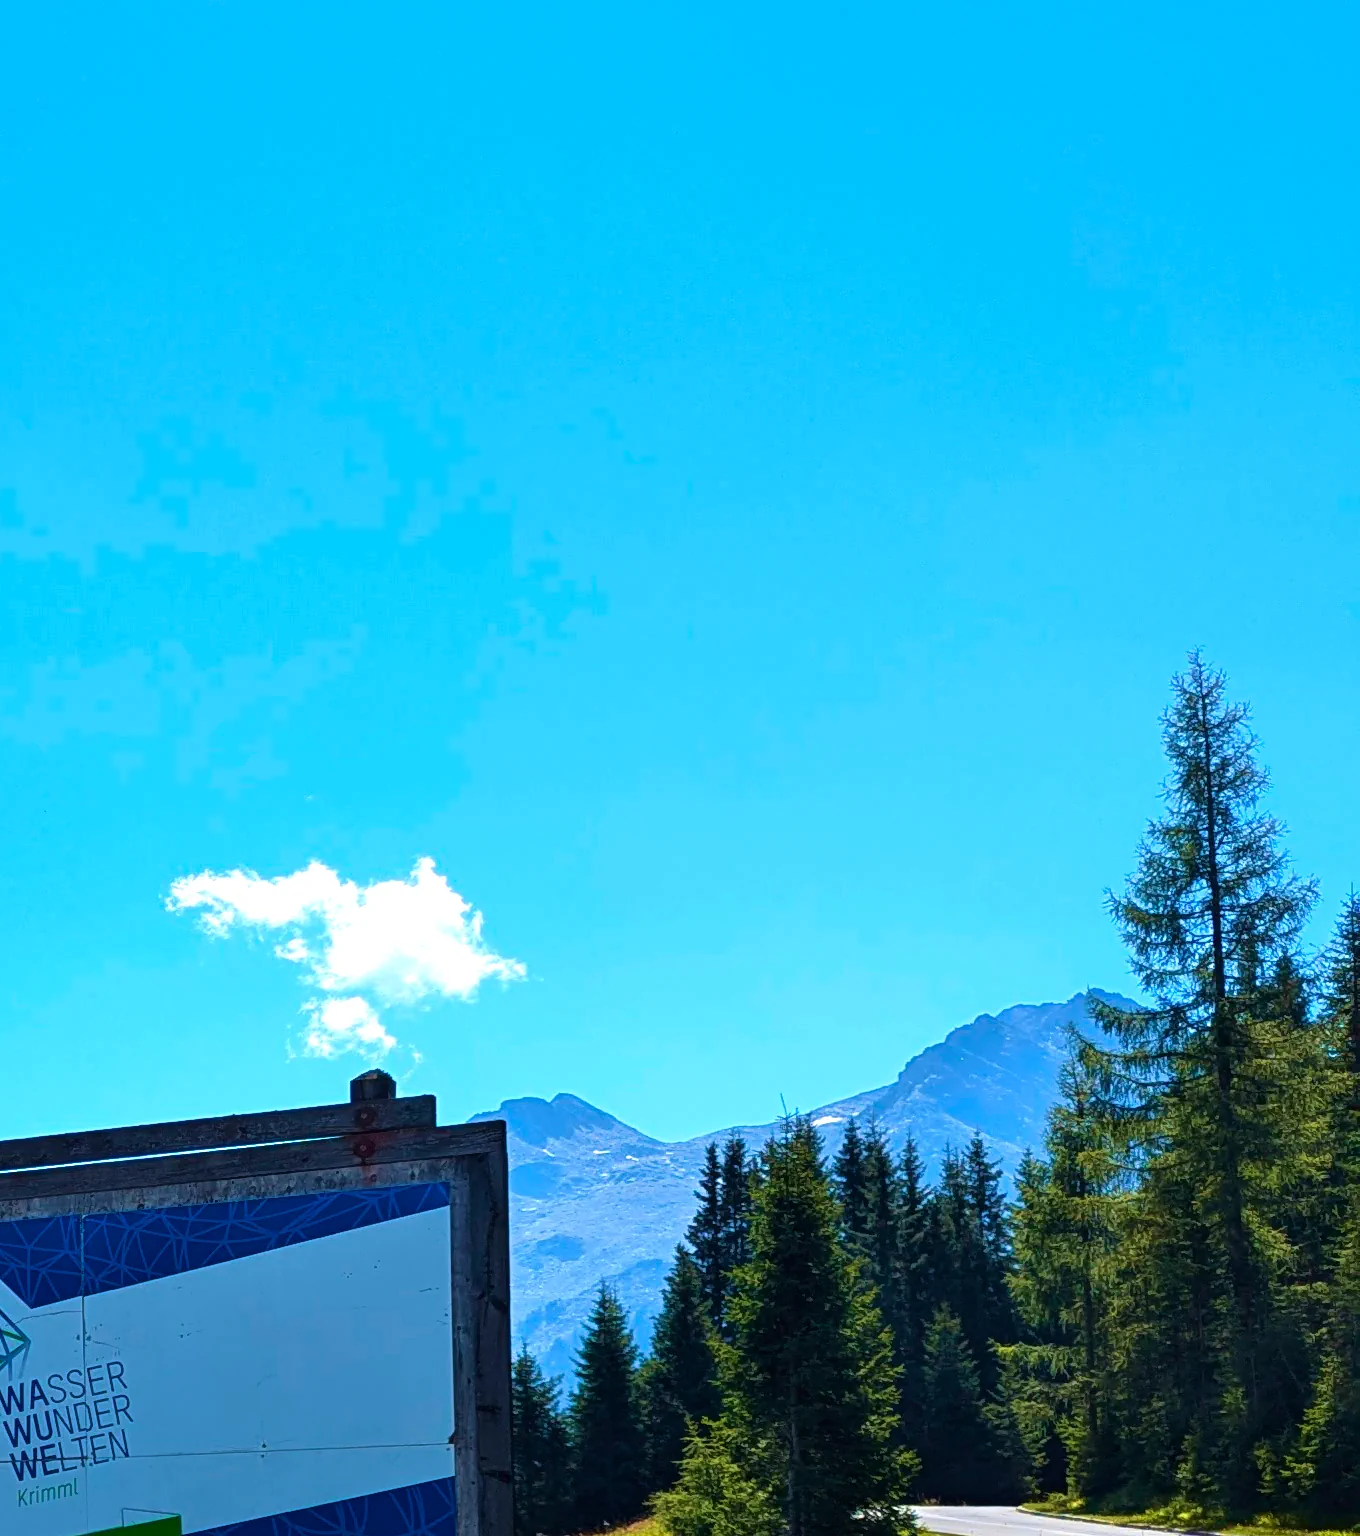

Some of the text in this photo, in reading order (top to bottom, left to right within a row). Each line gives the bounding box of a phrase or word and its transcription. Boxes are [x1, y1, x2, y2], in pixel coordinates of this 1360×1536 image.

[3, 1394, 134, 1448] WUNDER
[9, 1429, 130, 1482] WELTEN
[18, 1477, 79, 1508] Krimml
